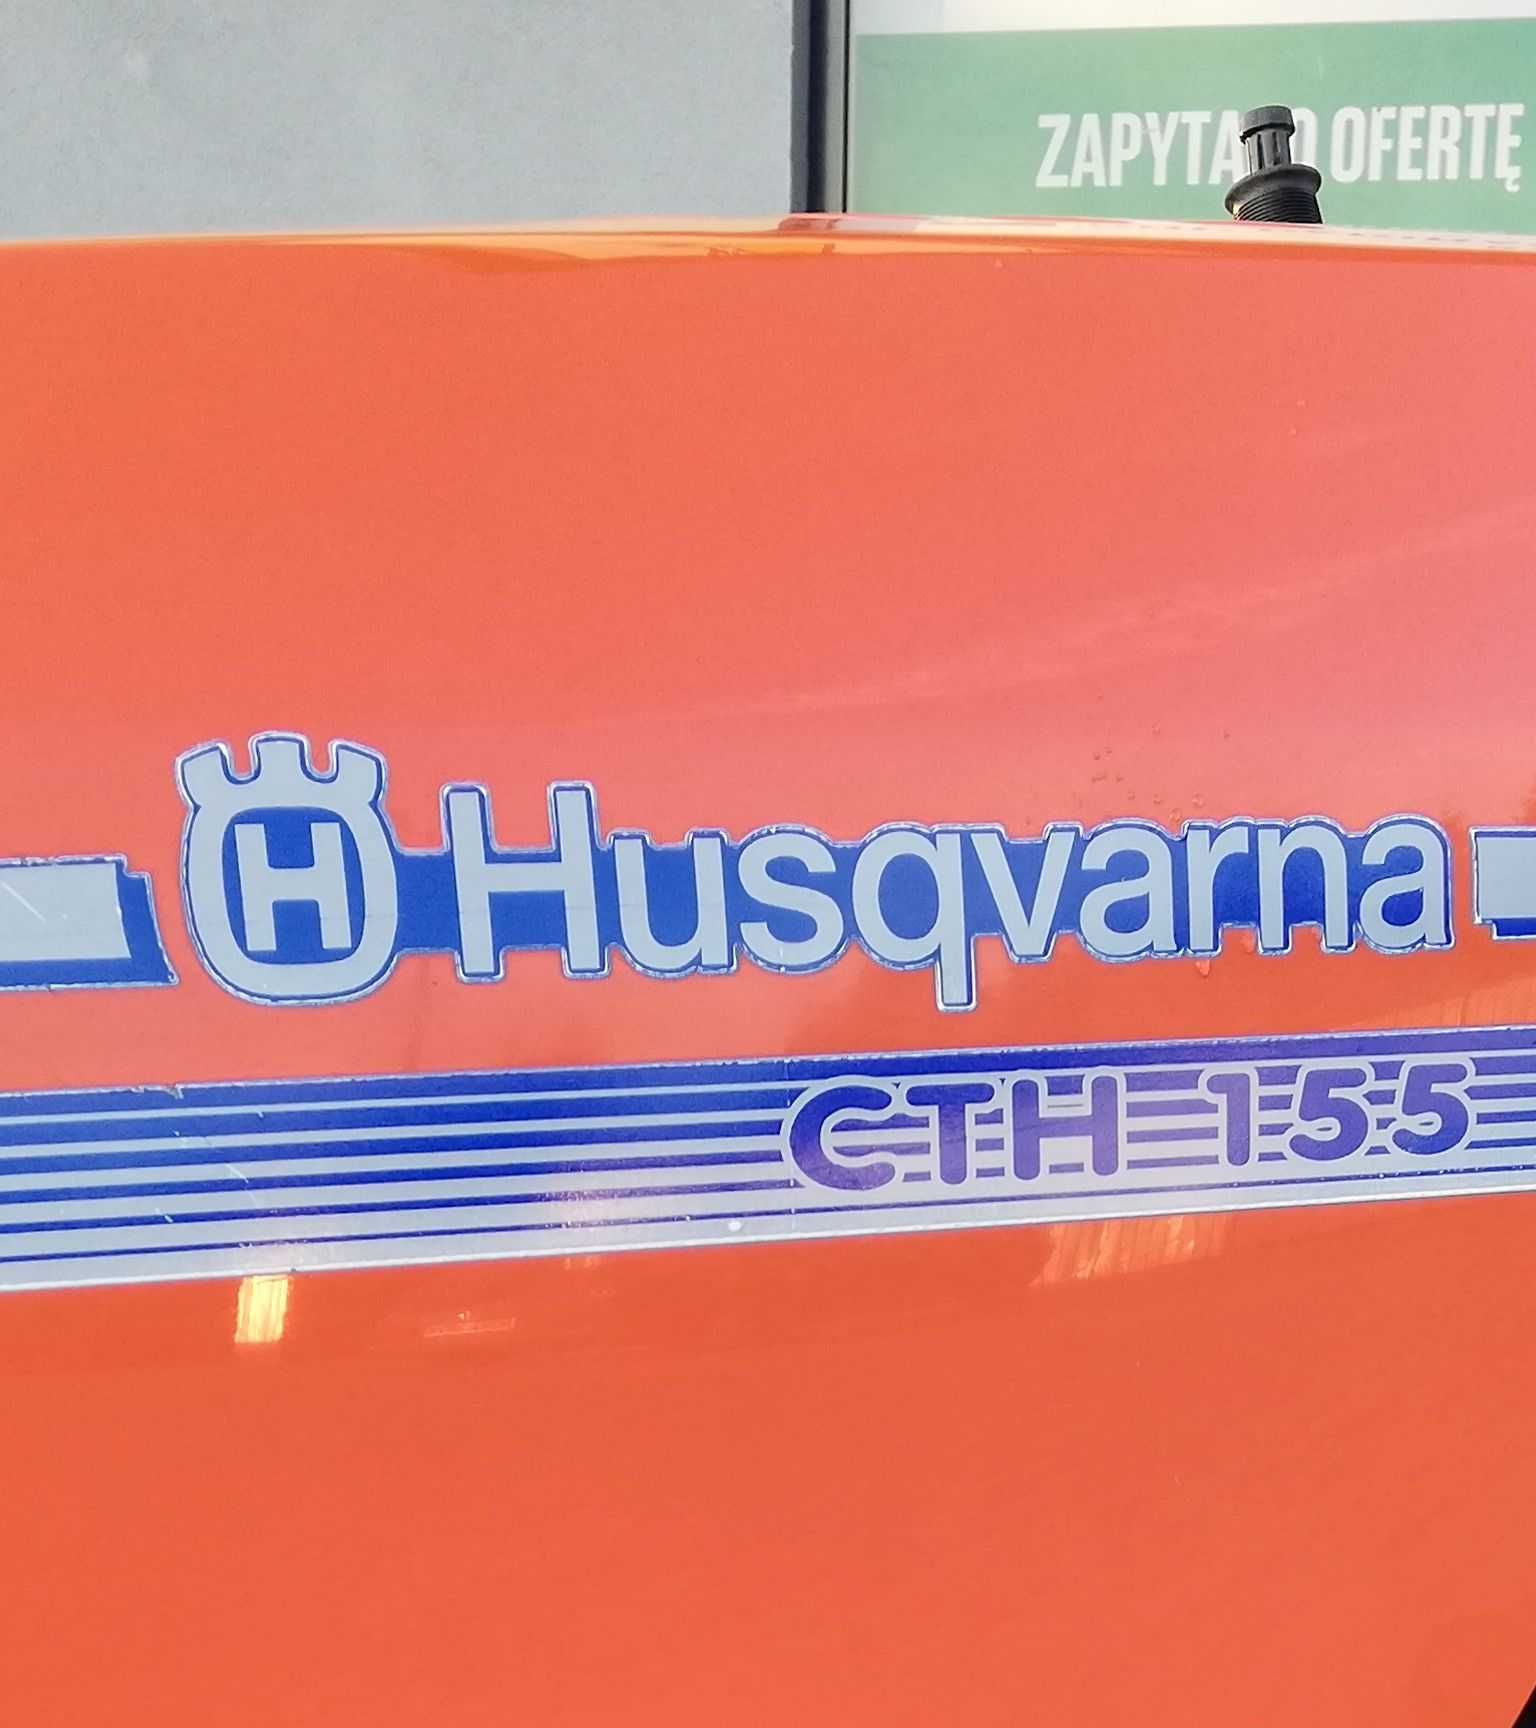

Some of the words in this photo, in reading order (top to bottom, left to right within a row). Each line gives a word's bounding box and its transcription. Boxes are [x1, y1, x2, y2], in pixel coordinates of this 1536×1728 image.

[1035, 110, 1254, 188] ZAPYTA
[1329, 102, 1525, 193] OFERTĘ
[446, 787, 1452, 1006] Husqvarna
[788, 1074, 1120, 1191] CTH
[1206, 1061, 1470, 1168] 155
